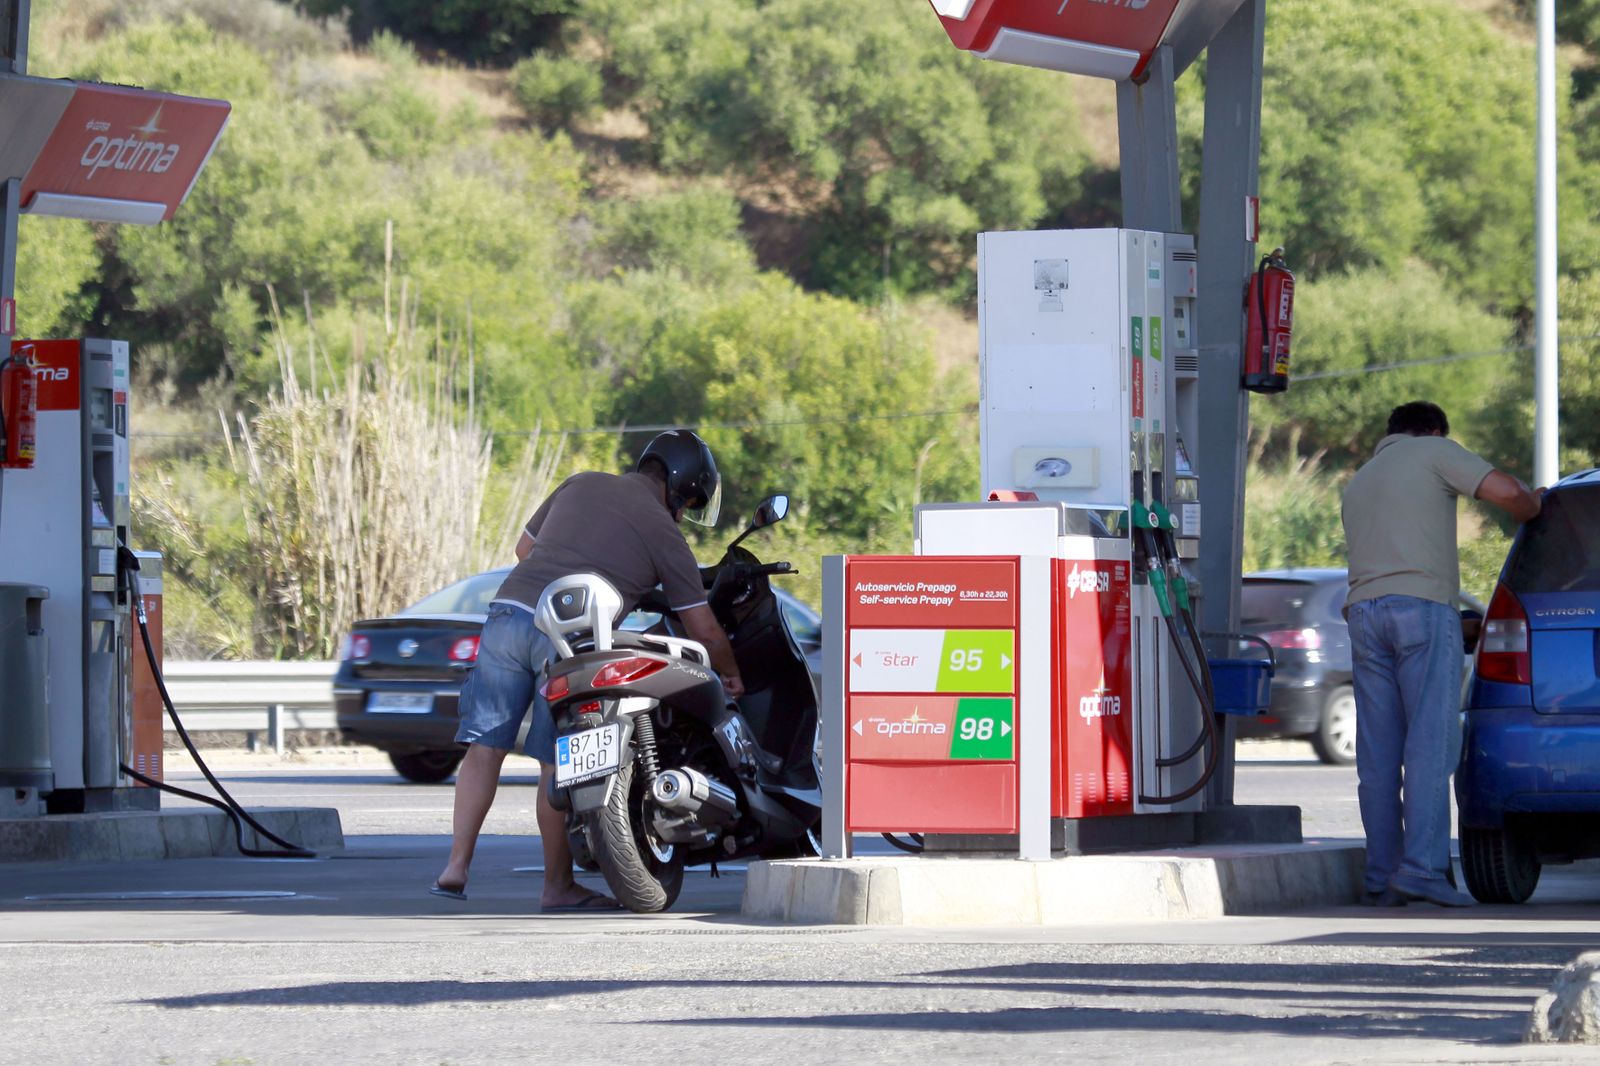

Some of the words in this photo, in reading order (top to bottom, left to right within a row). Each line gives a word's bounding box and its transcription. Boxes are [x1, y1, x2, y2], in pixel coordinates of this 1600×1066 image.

[80, 134, 180, 180] optima
[855, 583, 915, 592] Autoservicio
[916, 582, 957, 594] Prepago
[860, 595, 917, 605] Self-service
[919, 595, 954, 606] Prepay
[883, 653, 919, 667] star
[949, 648, 983, 672] 95
[1080, 694, 1120, 725] optima
[877, 720, 947, 738] optima
[960, 717, 994, 741] 98
[570, 728, 613, 755] 8715
[560, 753, 567, 762] E
[573, 749, 607, 774] HGD
